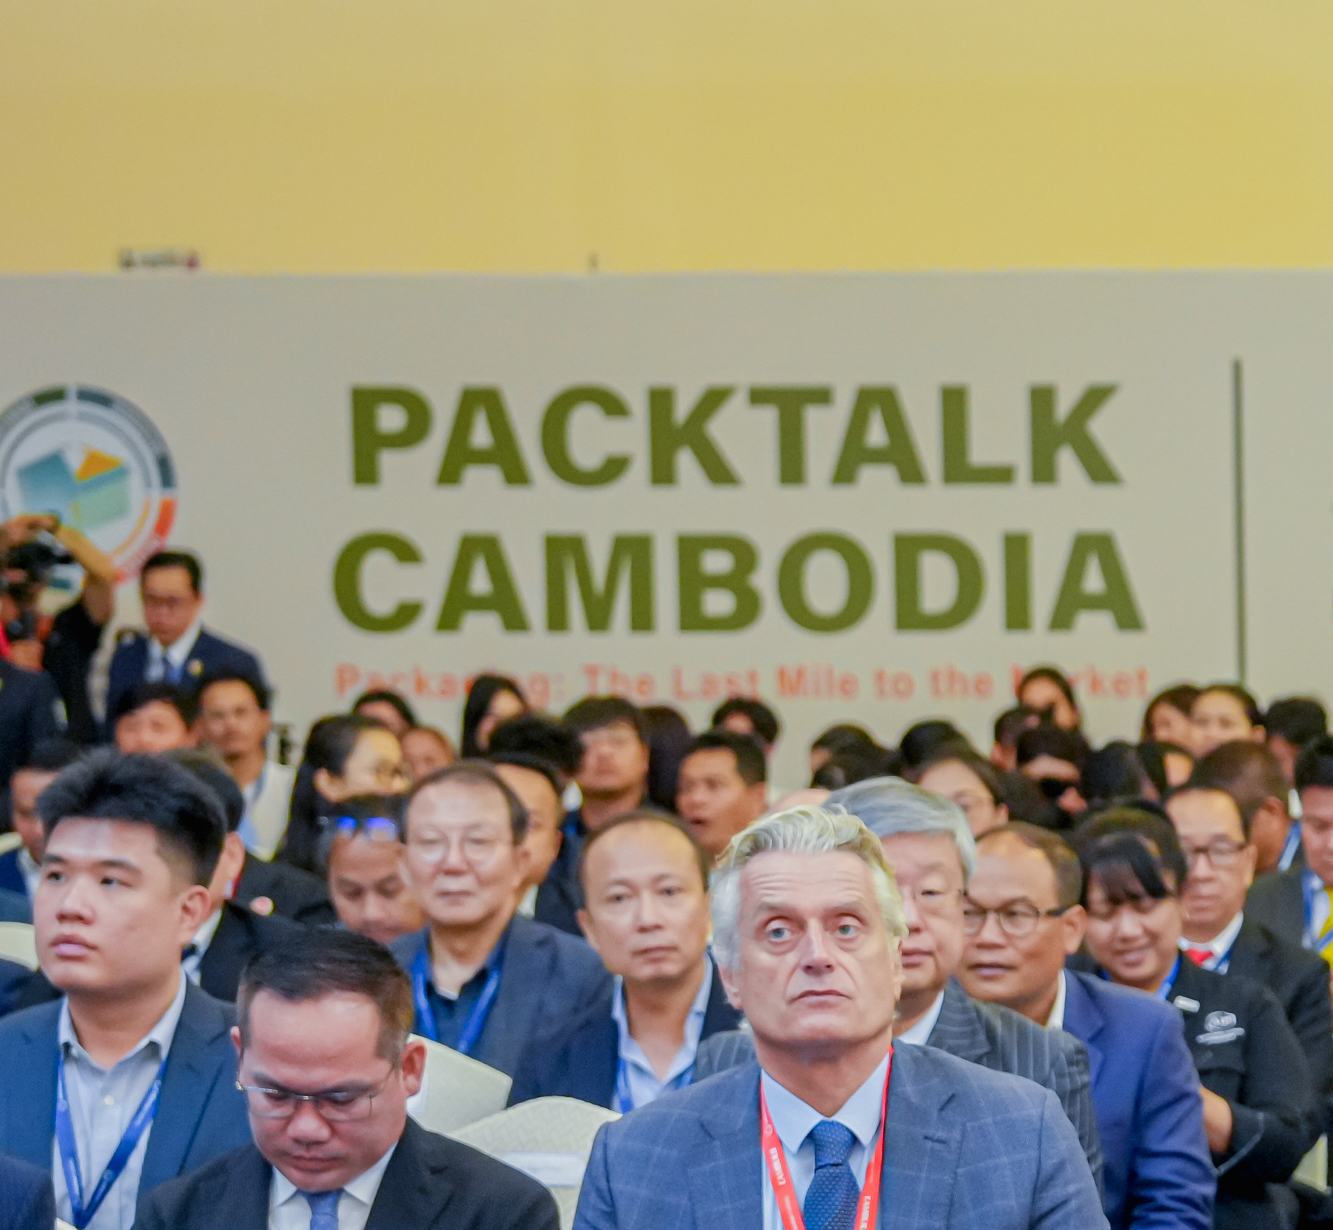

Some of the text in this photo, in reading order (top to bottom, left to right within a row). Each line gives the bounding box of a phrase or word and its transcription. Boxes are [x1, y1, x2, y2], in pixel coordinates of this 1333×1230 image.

[349, 384, 1121, 488] PACKTALK
[331, 530, 1145, 635] CAMBODIA
[582, 663, 655, 697] The
[673, 664, 763, 699] Last
[776, 664, 860, 699] Mile
[873, 667, 917, 699] to
[929, 666, 994, 699] the
